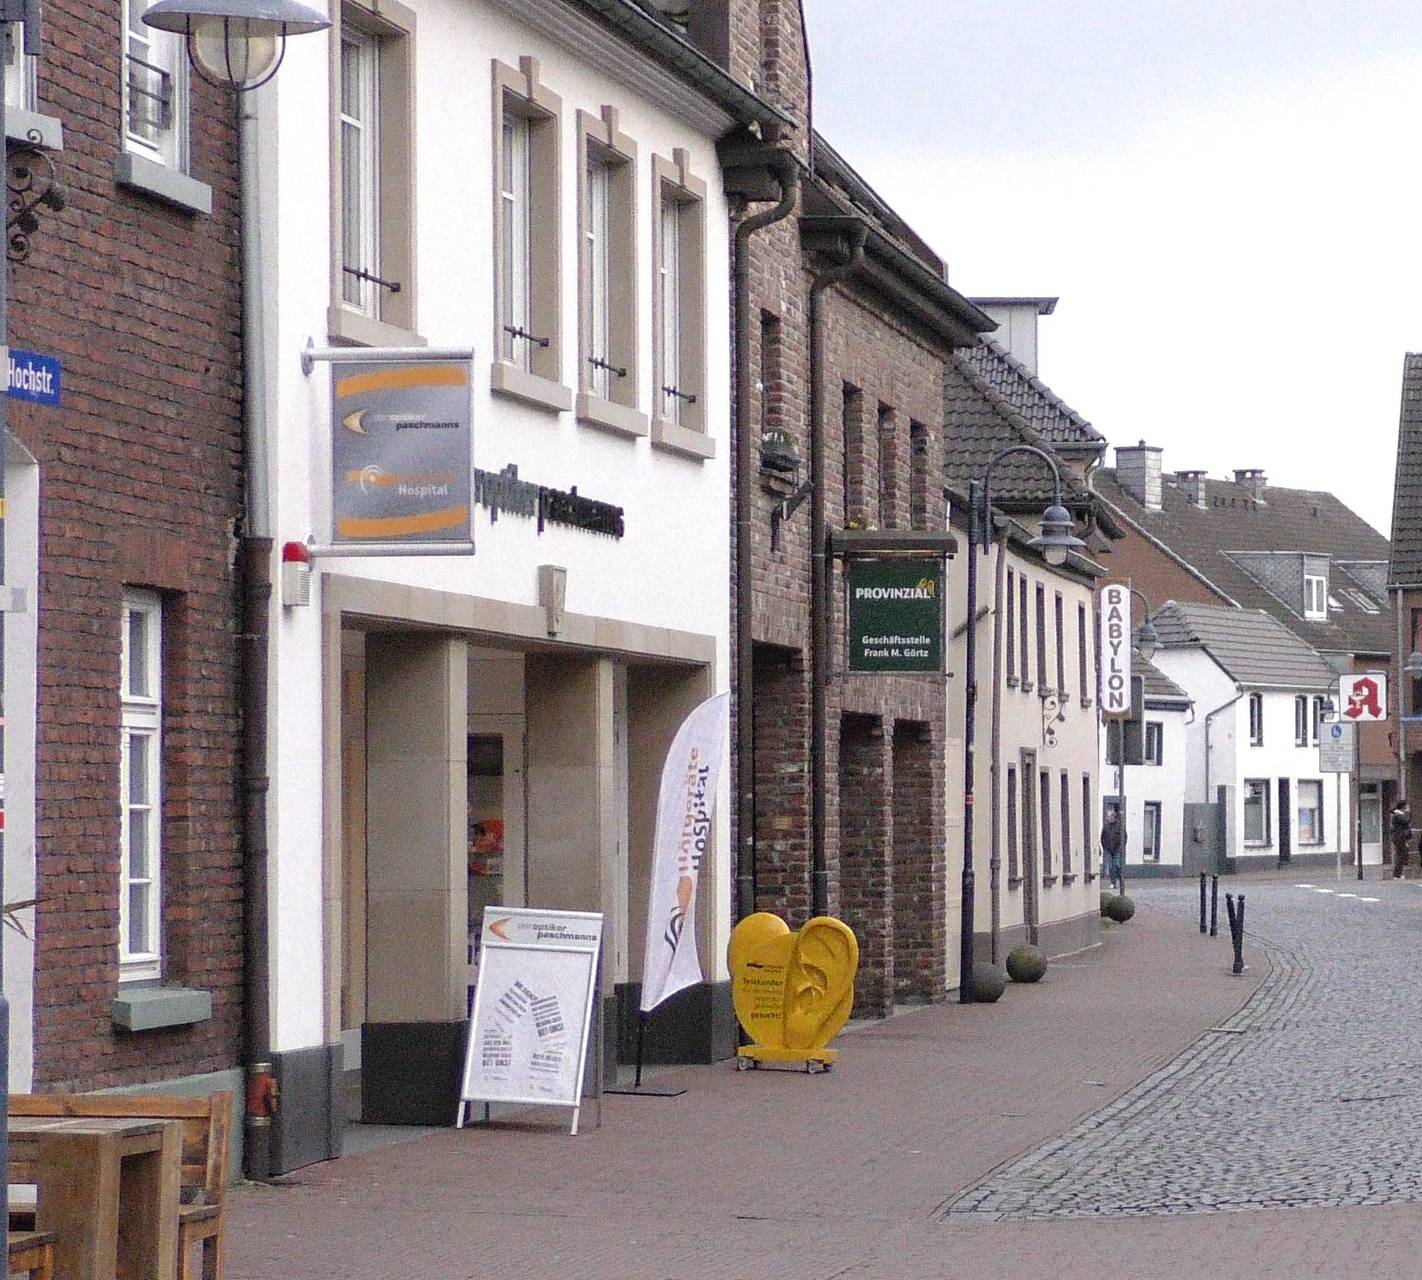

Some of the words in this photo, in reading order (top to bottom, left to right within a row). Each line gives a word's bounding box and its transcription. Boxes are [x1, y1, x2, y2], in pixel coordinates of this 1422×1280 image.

[9, 357, 55, 395] Hochstr.
[395, 421, 459, 432] paschmanns
[398, 484, 449, 498] Hospital
[855, 587, 931, 599] PROVINZIAL
[862, 635, 931, 644] Geschäftsstelle
[864, 648, 889, 657] Frank
[891, 648, 902, 657] M.
[1107, 589, 1124, 708] BABYLON
[691, 765, 711, 871] Hospital
[537, 931, 598, 941] paschmanns
